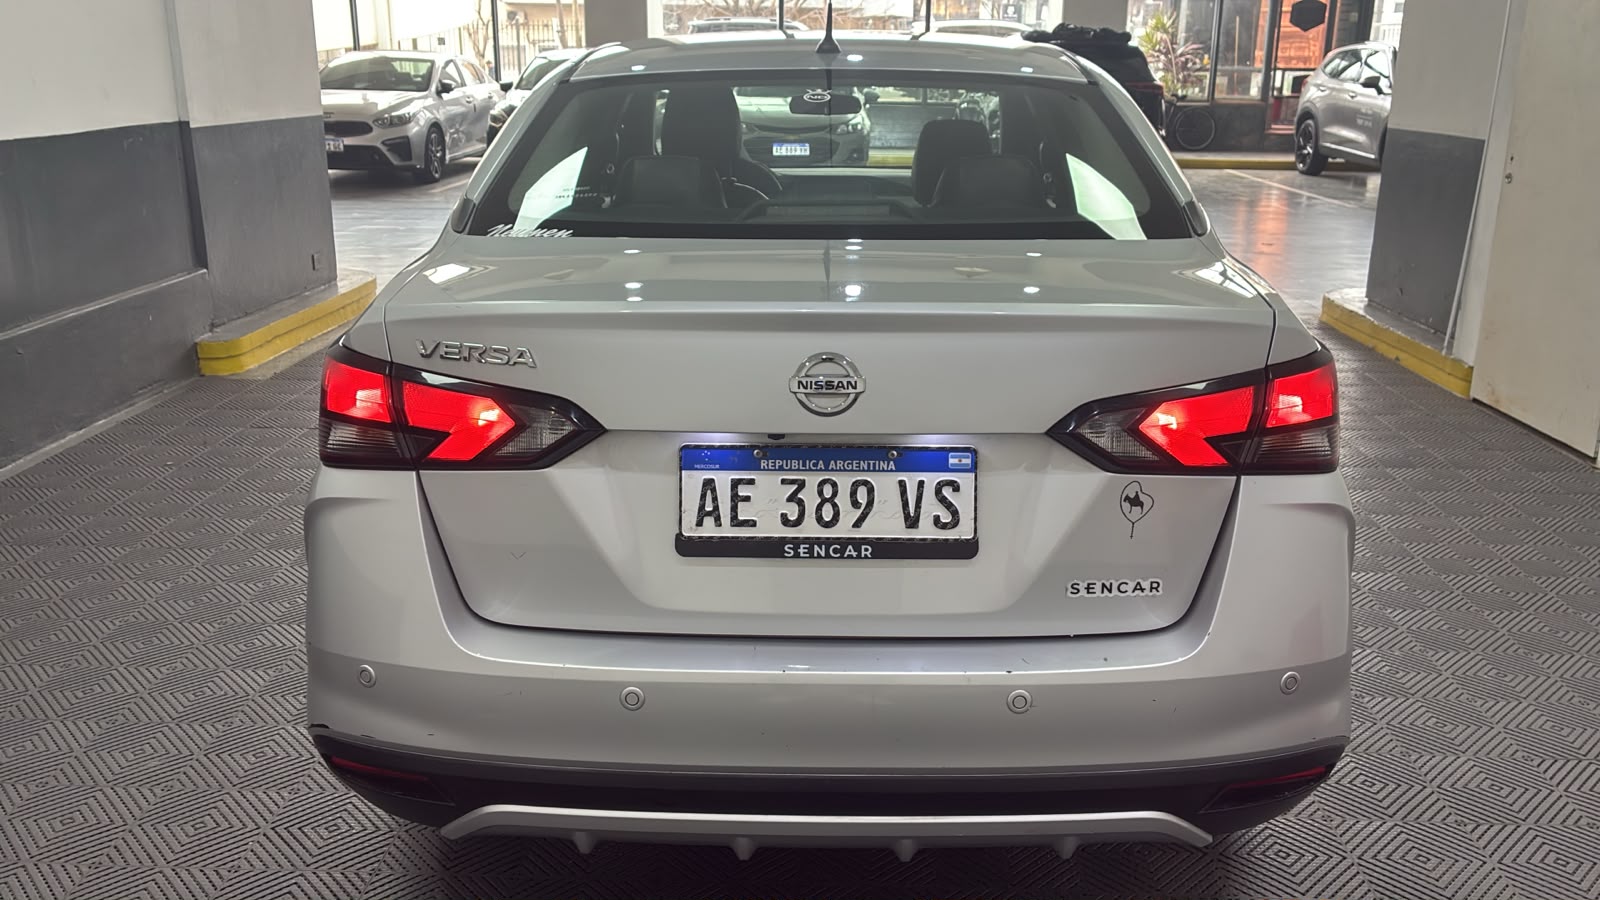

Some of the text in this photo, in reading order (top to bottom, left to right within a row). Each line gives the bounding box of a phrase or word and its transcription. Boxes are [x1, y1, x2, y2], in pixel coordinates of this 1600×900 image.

[416, 339, 537, 368] VERSA
[797, 380, 858, 391] NISSAN
[760, 459, 896, 471] REPUBLICA ARGENTINA
[695, 477, 961, 530] AE 389 VS
[783, 543, 873, 559] SENCAR
[1069, 580, 1161, 596] SENCAR
